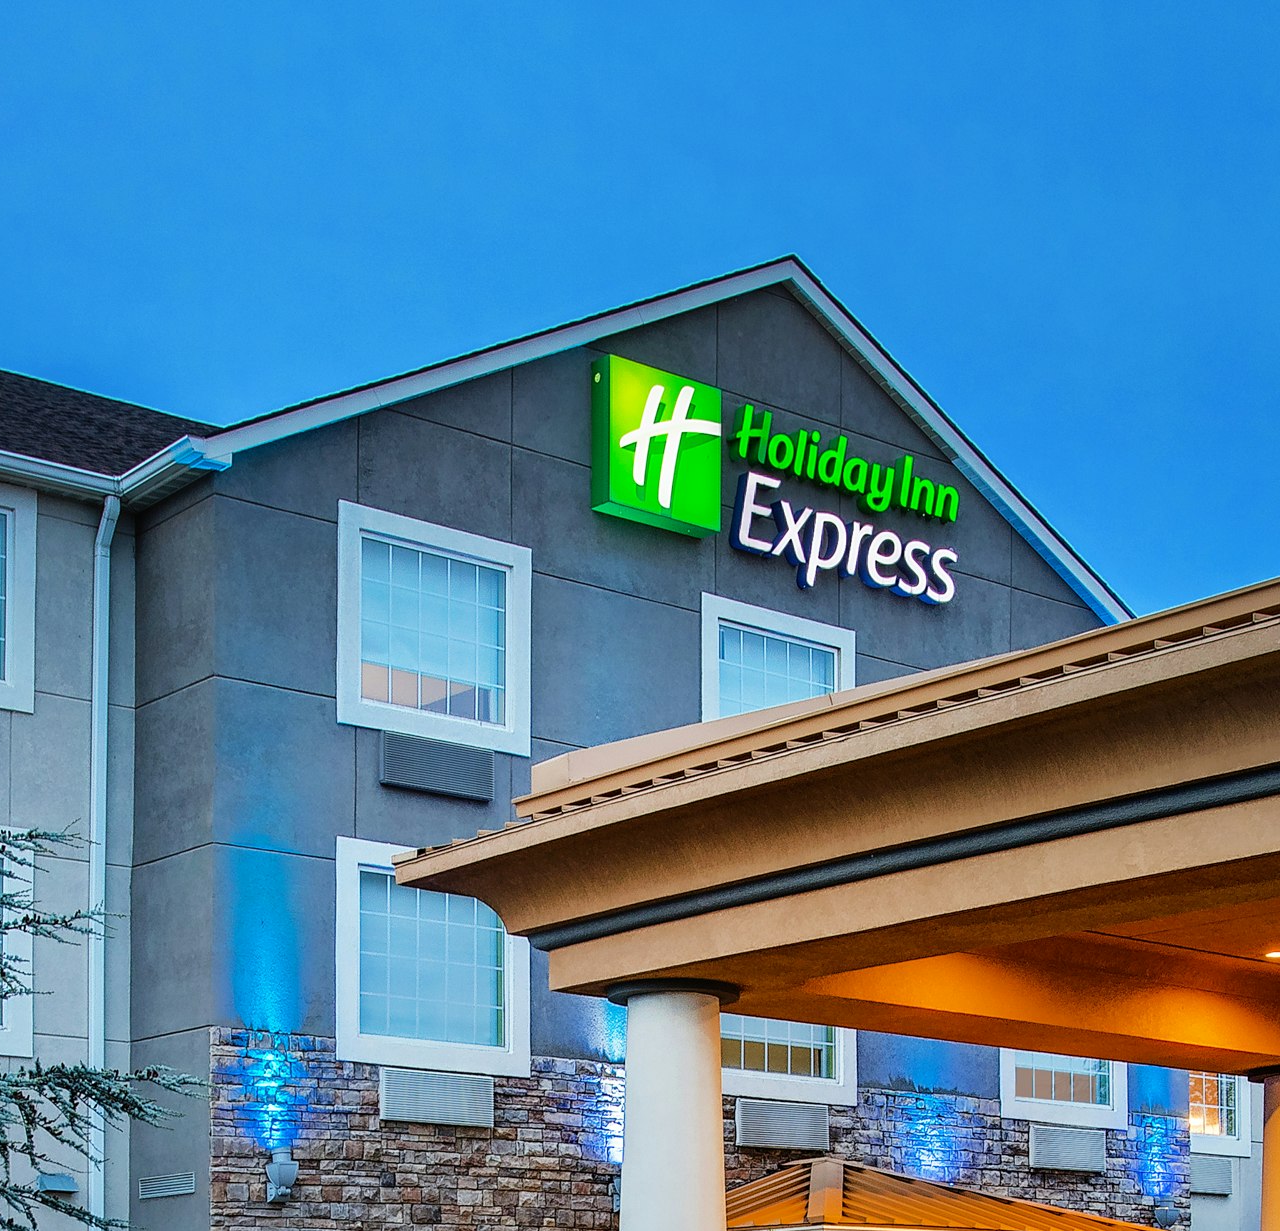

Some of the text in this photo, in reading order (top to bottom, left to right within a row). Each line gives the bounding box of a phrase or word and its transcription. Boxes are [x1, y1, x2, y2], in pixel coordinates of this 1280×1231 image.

[733, 403, 960, 523] Holiday Inn
[734, 470, 960, 605] Express
